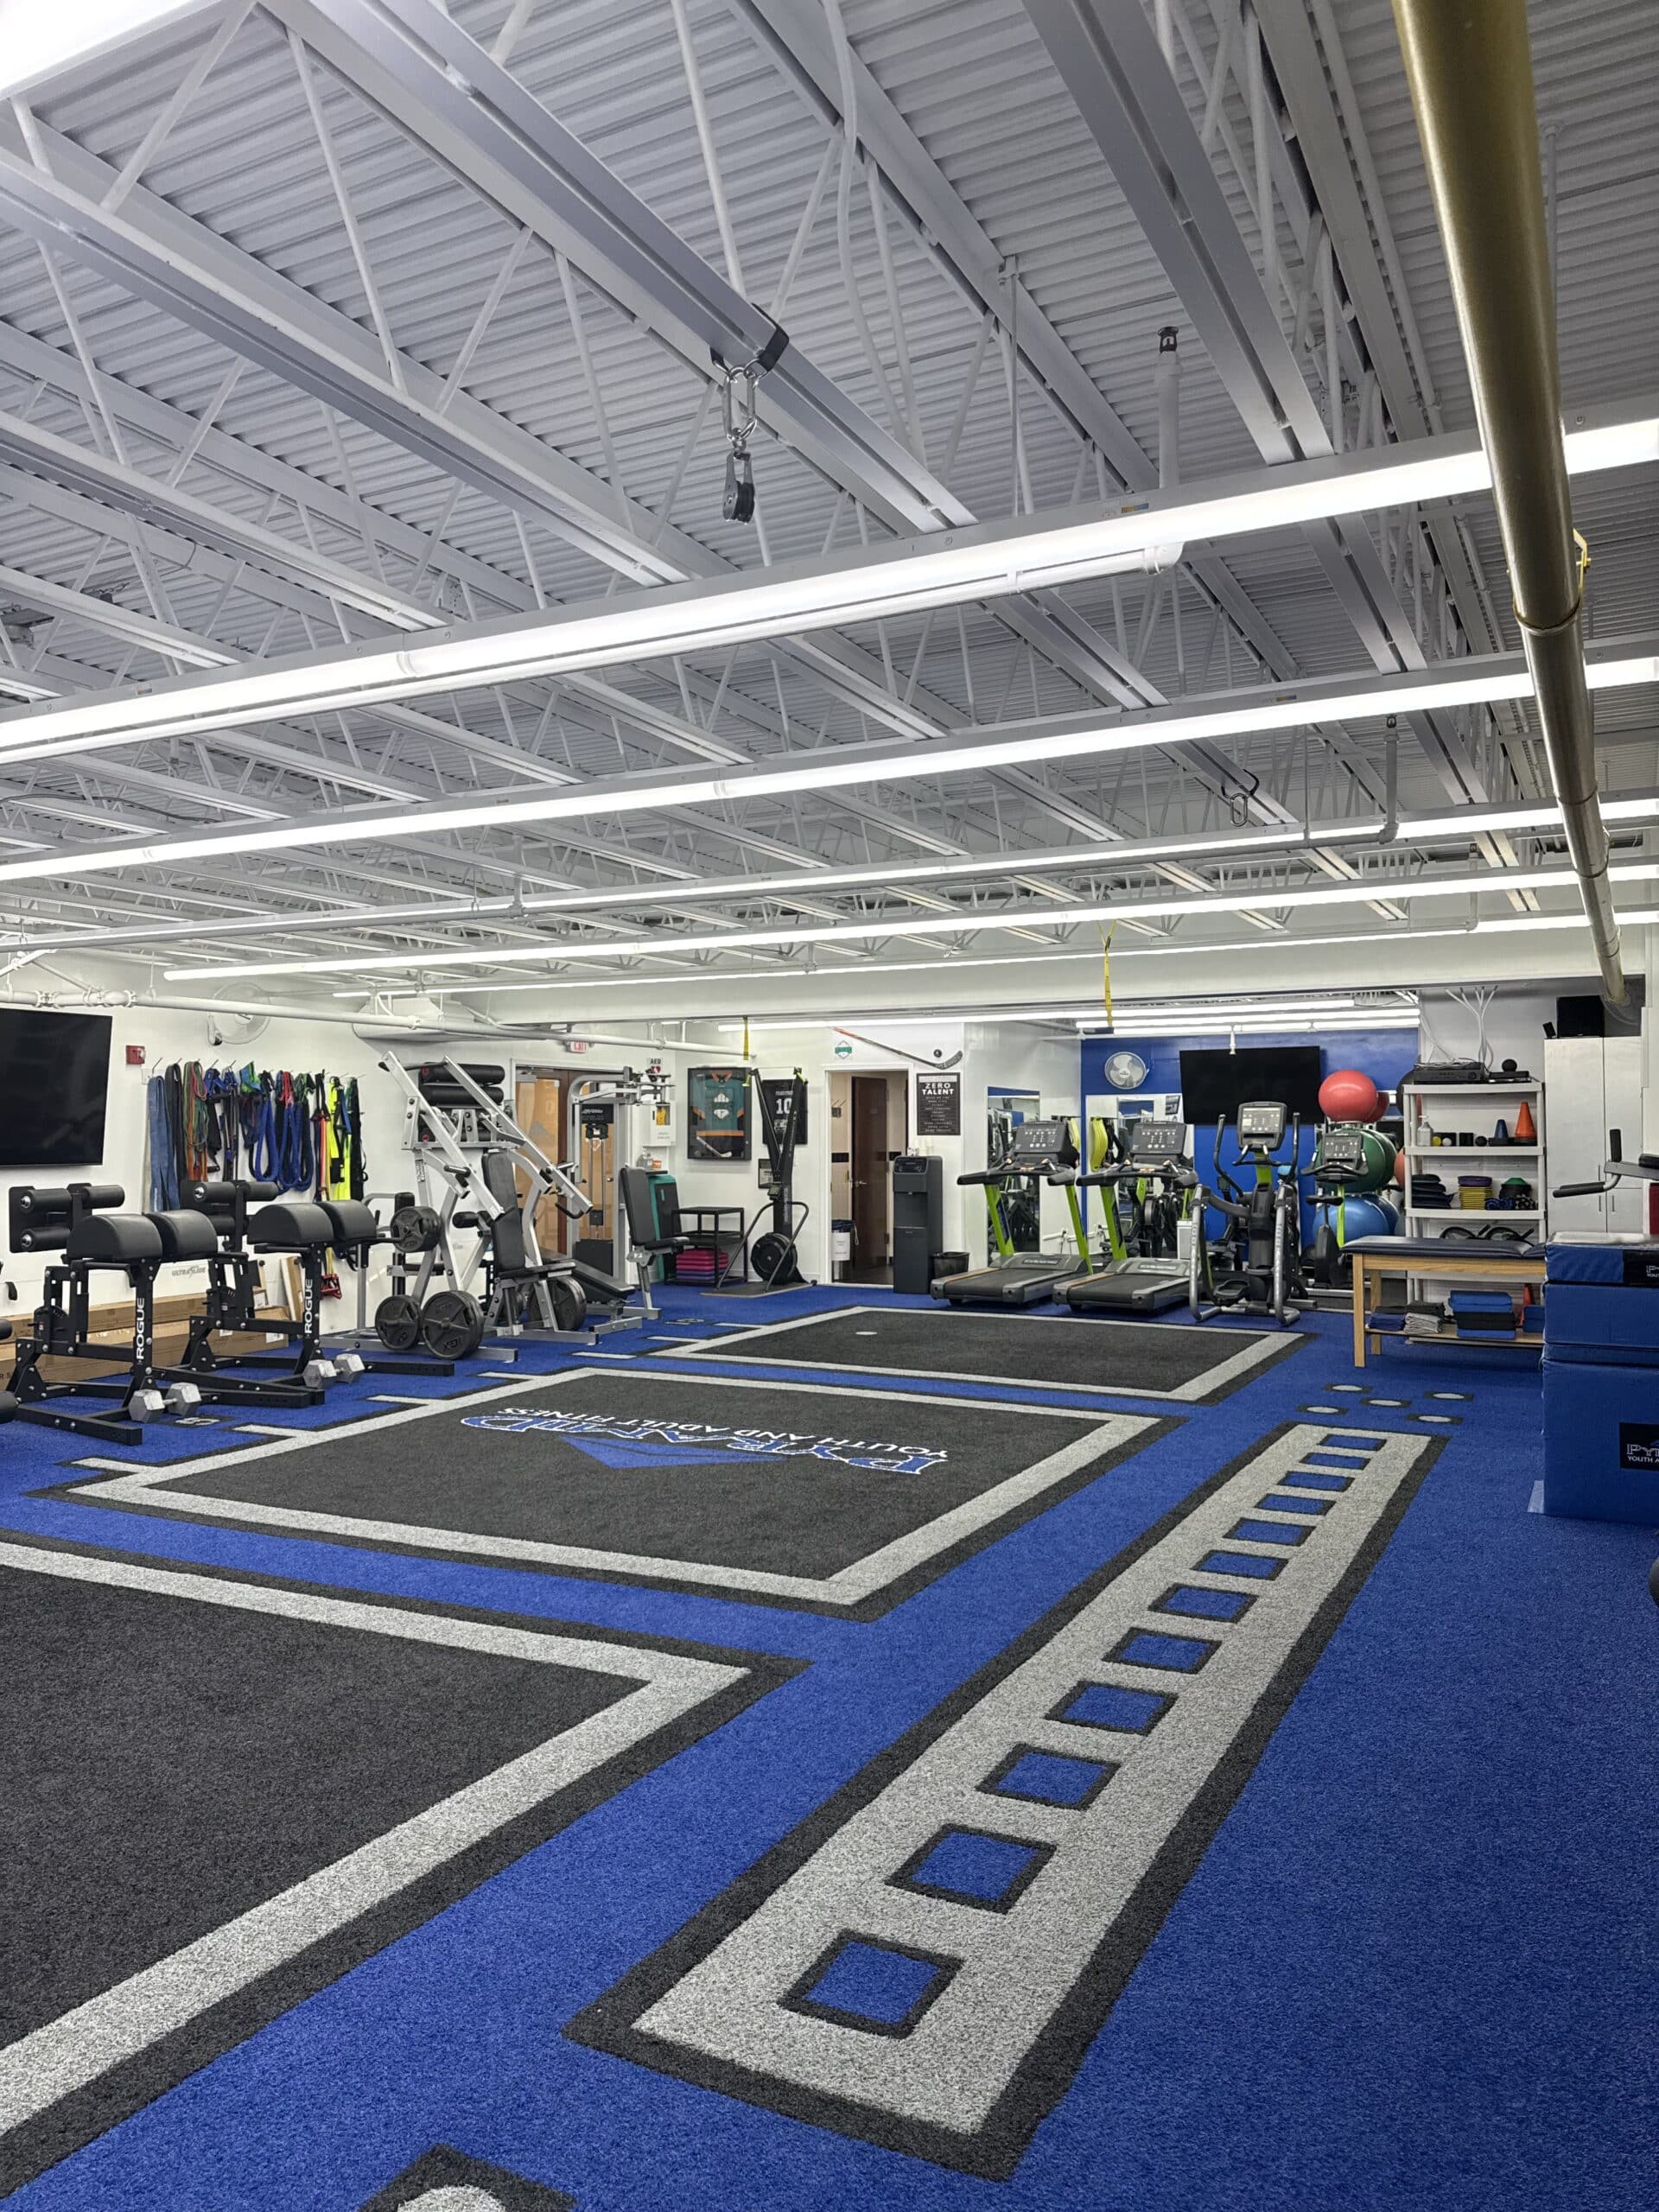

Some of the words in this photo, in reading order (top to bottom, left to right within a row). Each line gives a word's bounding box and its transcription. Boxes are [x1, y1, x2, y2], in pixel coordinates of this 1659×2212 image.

[776, 1098, 792, 1115] 10
[304, 1279, 314, 1335] ROGUE
[137, 1297, 145, 1360] ROGUE
[498, 1407, 615, 1422] FITNESS
[615, 1419, 729, 1433] ADULT
[461, 1414, 948, 1475] PYRAMID
[733, 1429, 817, 1443] AND
[816, 1437, 949, 1458] YOUTH
